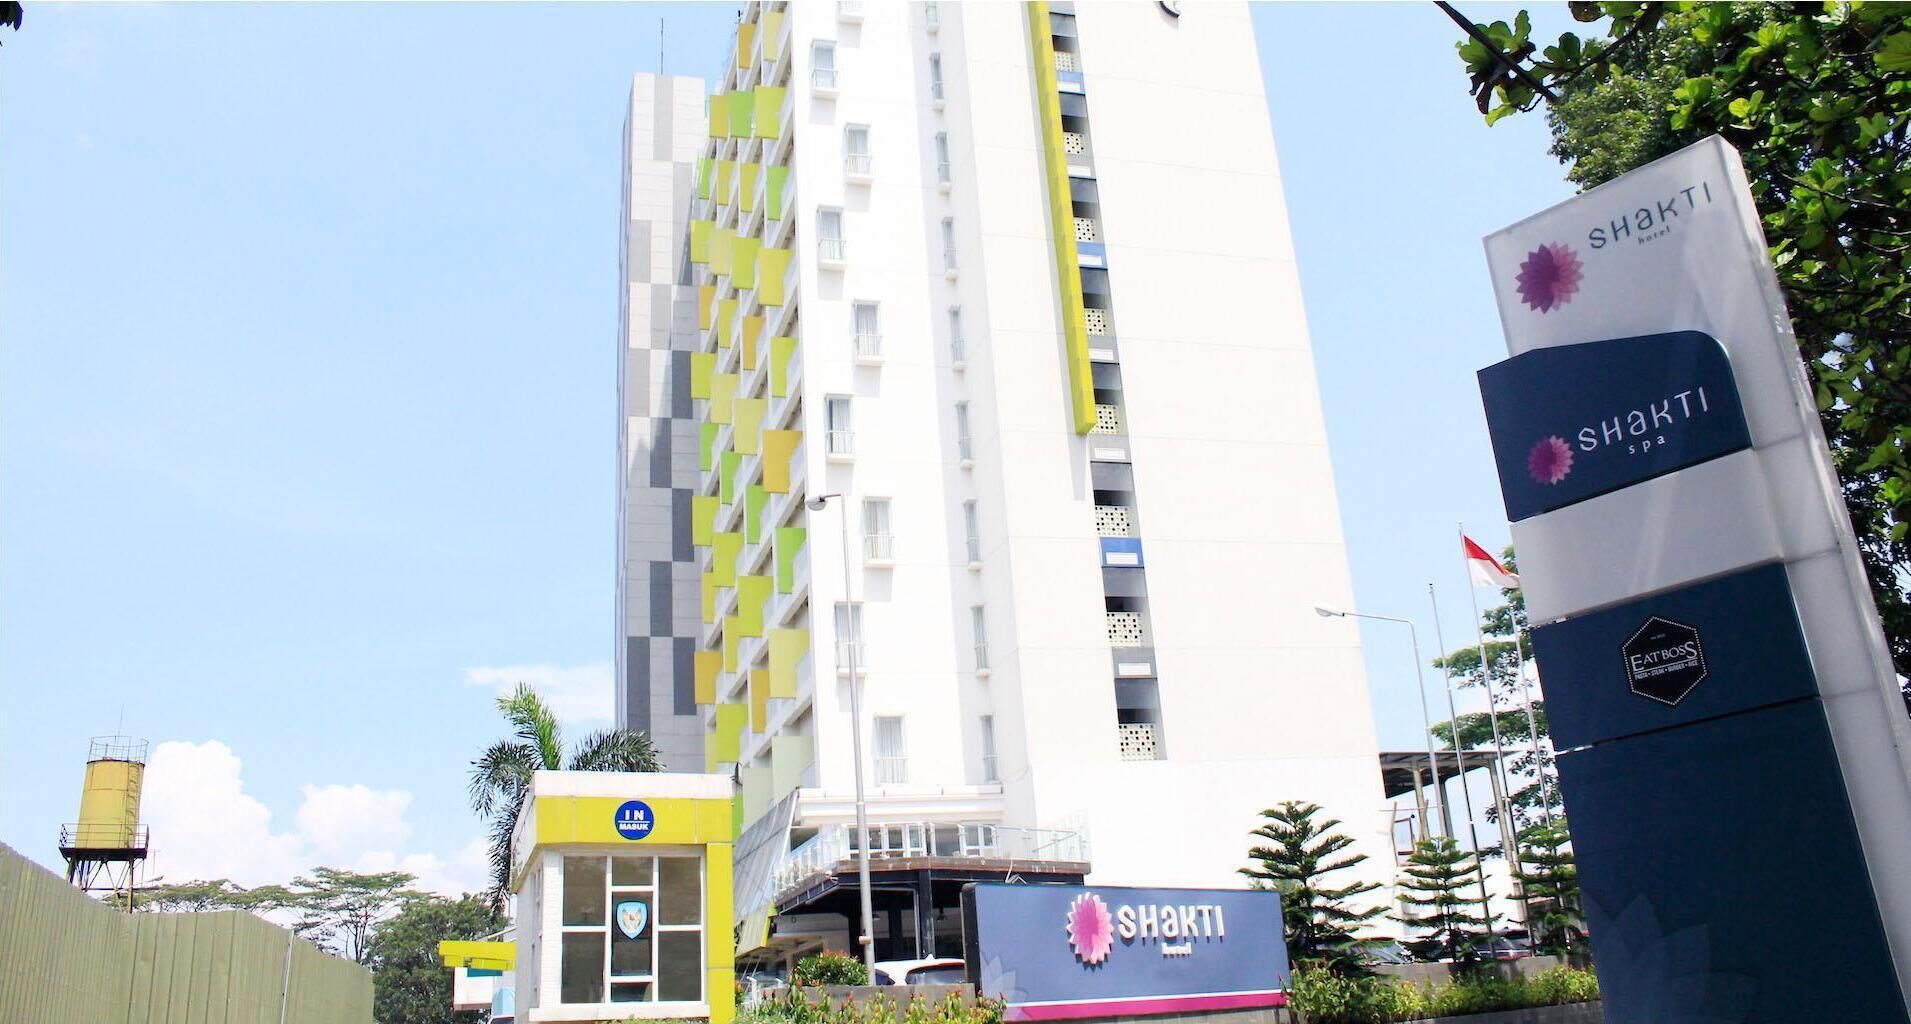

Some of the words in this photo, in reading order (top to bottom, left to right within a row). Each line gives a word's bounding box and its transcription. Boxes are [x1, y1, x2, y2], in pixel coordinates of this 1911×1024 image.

[1638, 225, 1671, 244] hotel
[1629, 435, 1665, 454] spa
[1630, 651, 1660, 672] EAT
[1661, 641, 1698, 660] BOSS
[625, 809, 644, 821] IN
[619, 823, 649, 831] MASUK
